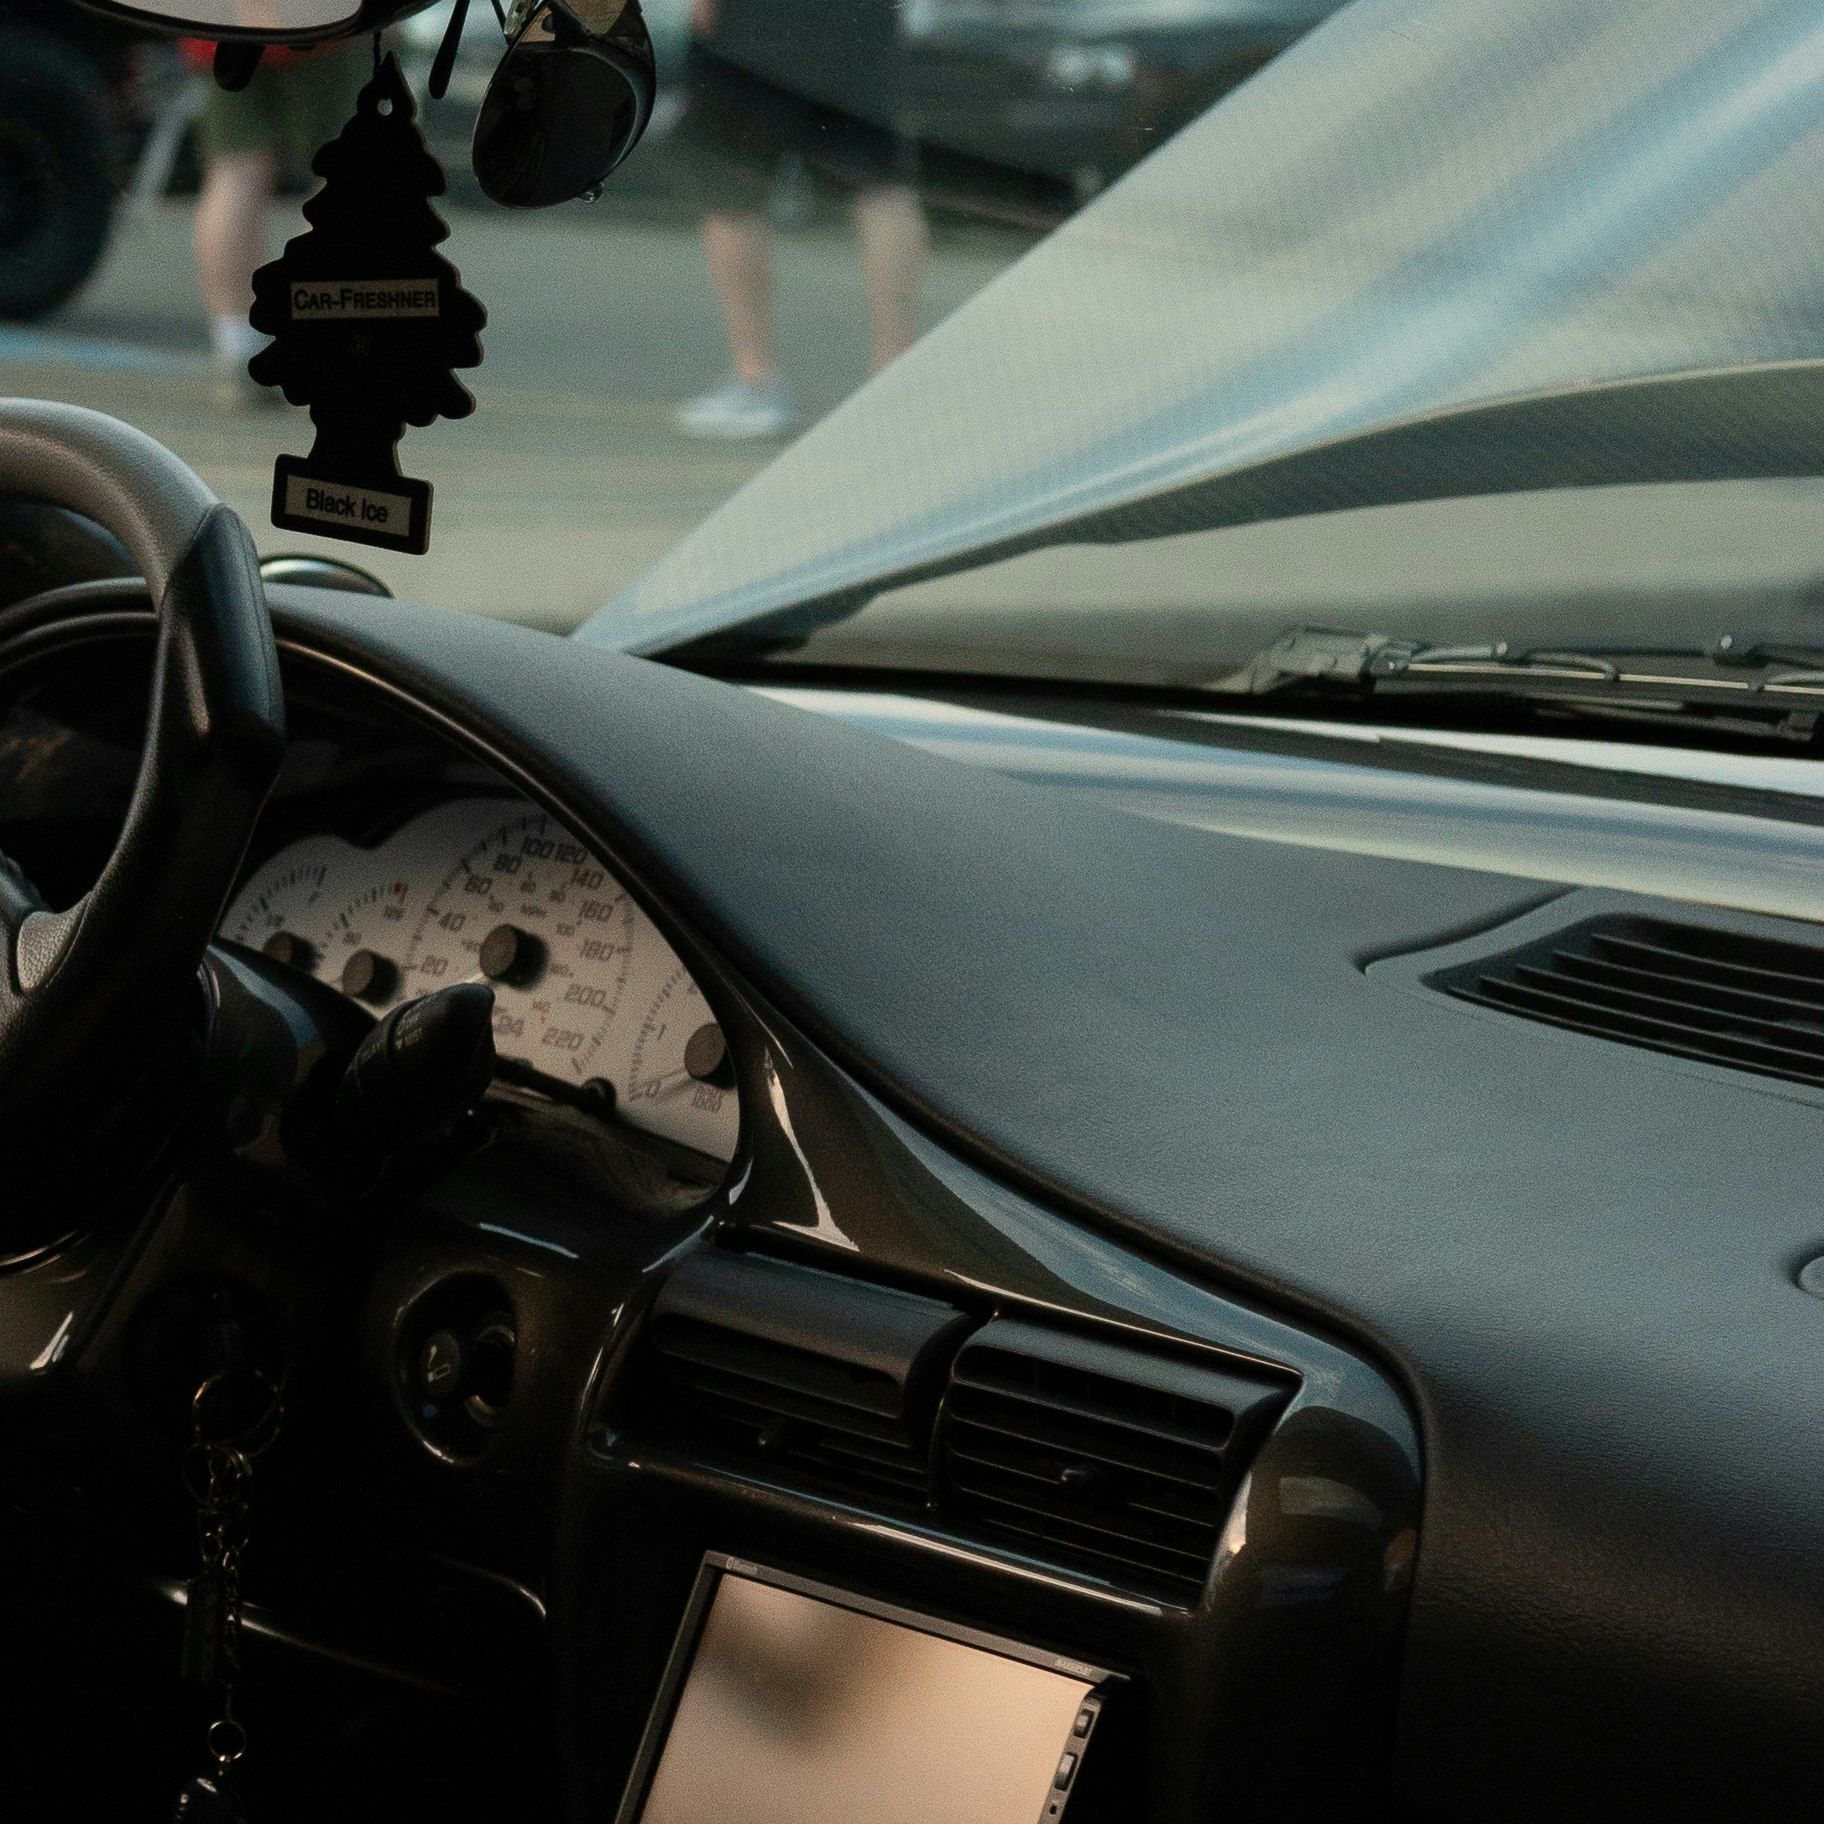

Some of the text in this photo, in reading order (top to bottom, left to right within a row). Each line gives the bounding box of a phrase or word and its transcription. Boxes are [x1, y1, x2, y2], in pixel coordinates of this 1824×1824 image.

[305, 486, 389, 524] Black Ice
[521, 835, 555, 860] 100
[555, 842, 589, 865] 120
[493, 852, 522, 874] 80
[463, 874, 494, 897] 60
[570, 866, 604, 890] 140
[437, 910, 467, 933] 40
[579, 899, 614, 923] 160
[579, 937, 616, 962] 180
[419, 954, 450, 977] 20
[563, 982, 608, 1009] 200
[540, 1025, 585, 1052] 220
